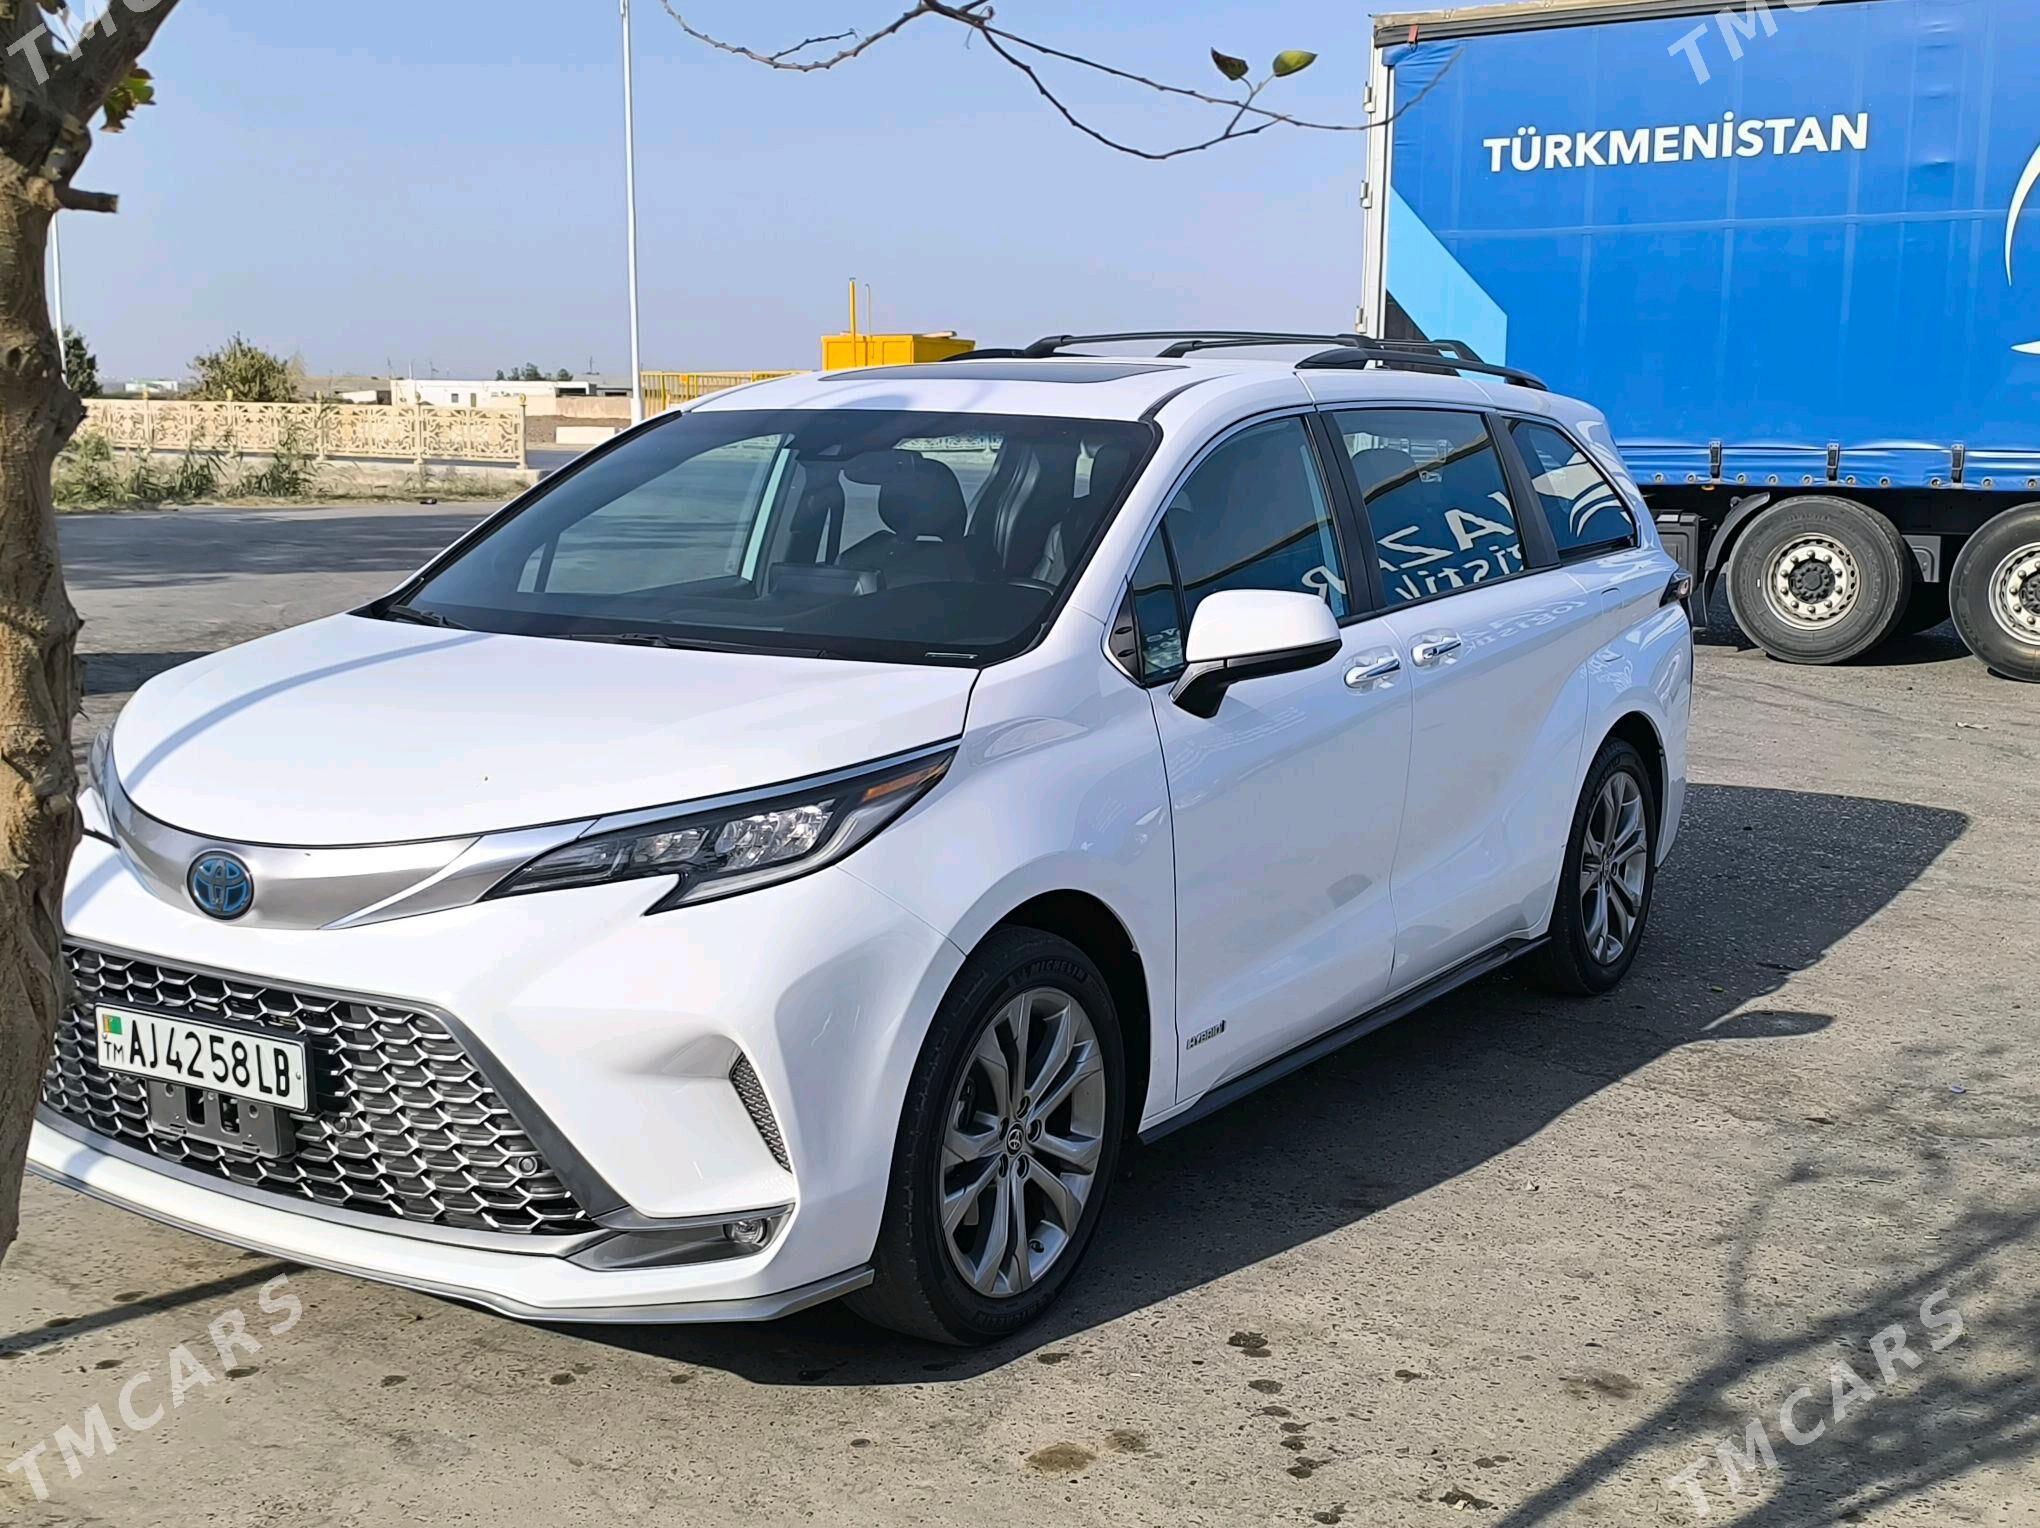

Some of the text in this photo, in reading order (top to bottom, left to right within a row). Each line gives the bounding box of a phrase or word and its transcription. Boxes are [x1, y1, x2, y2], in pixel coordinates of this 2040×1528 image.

[1482, 111, 1870, 174] TÜRKMENİSTAN
[103, 1041, 125, 1064] TM
[129, 1019, 291, 1099] AJ4258LB
